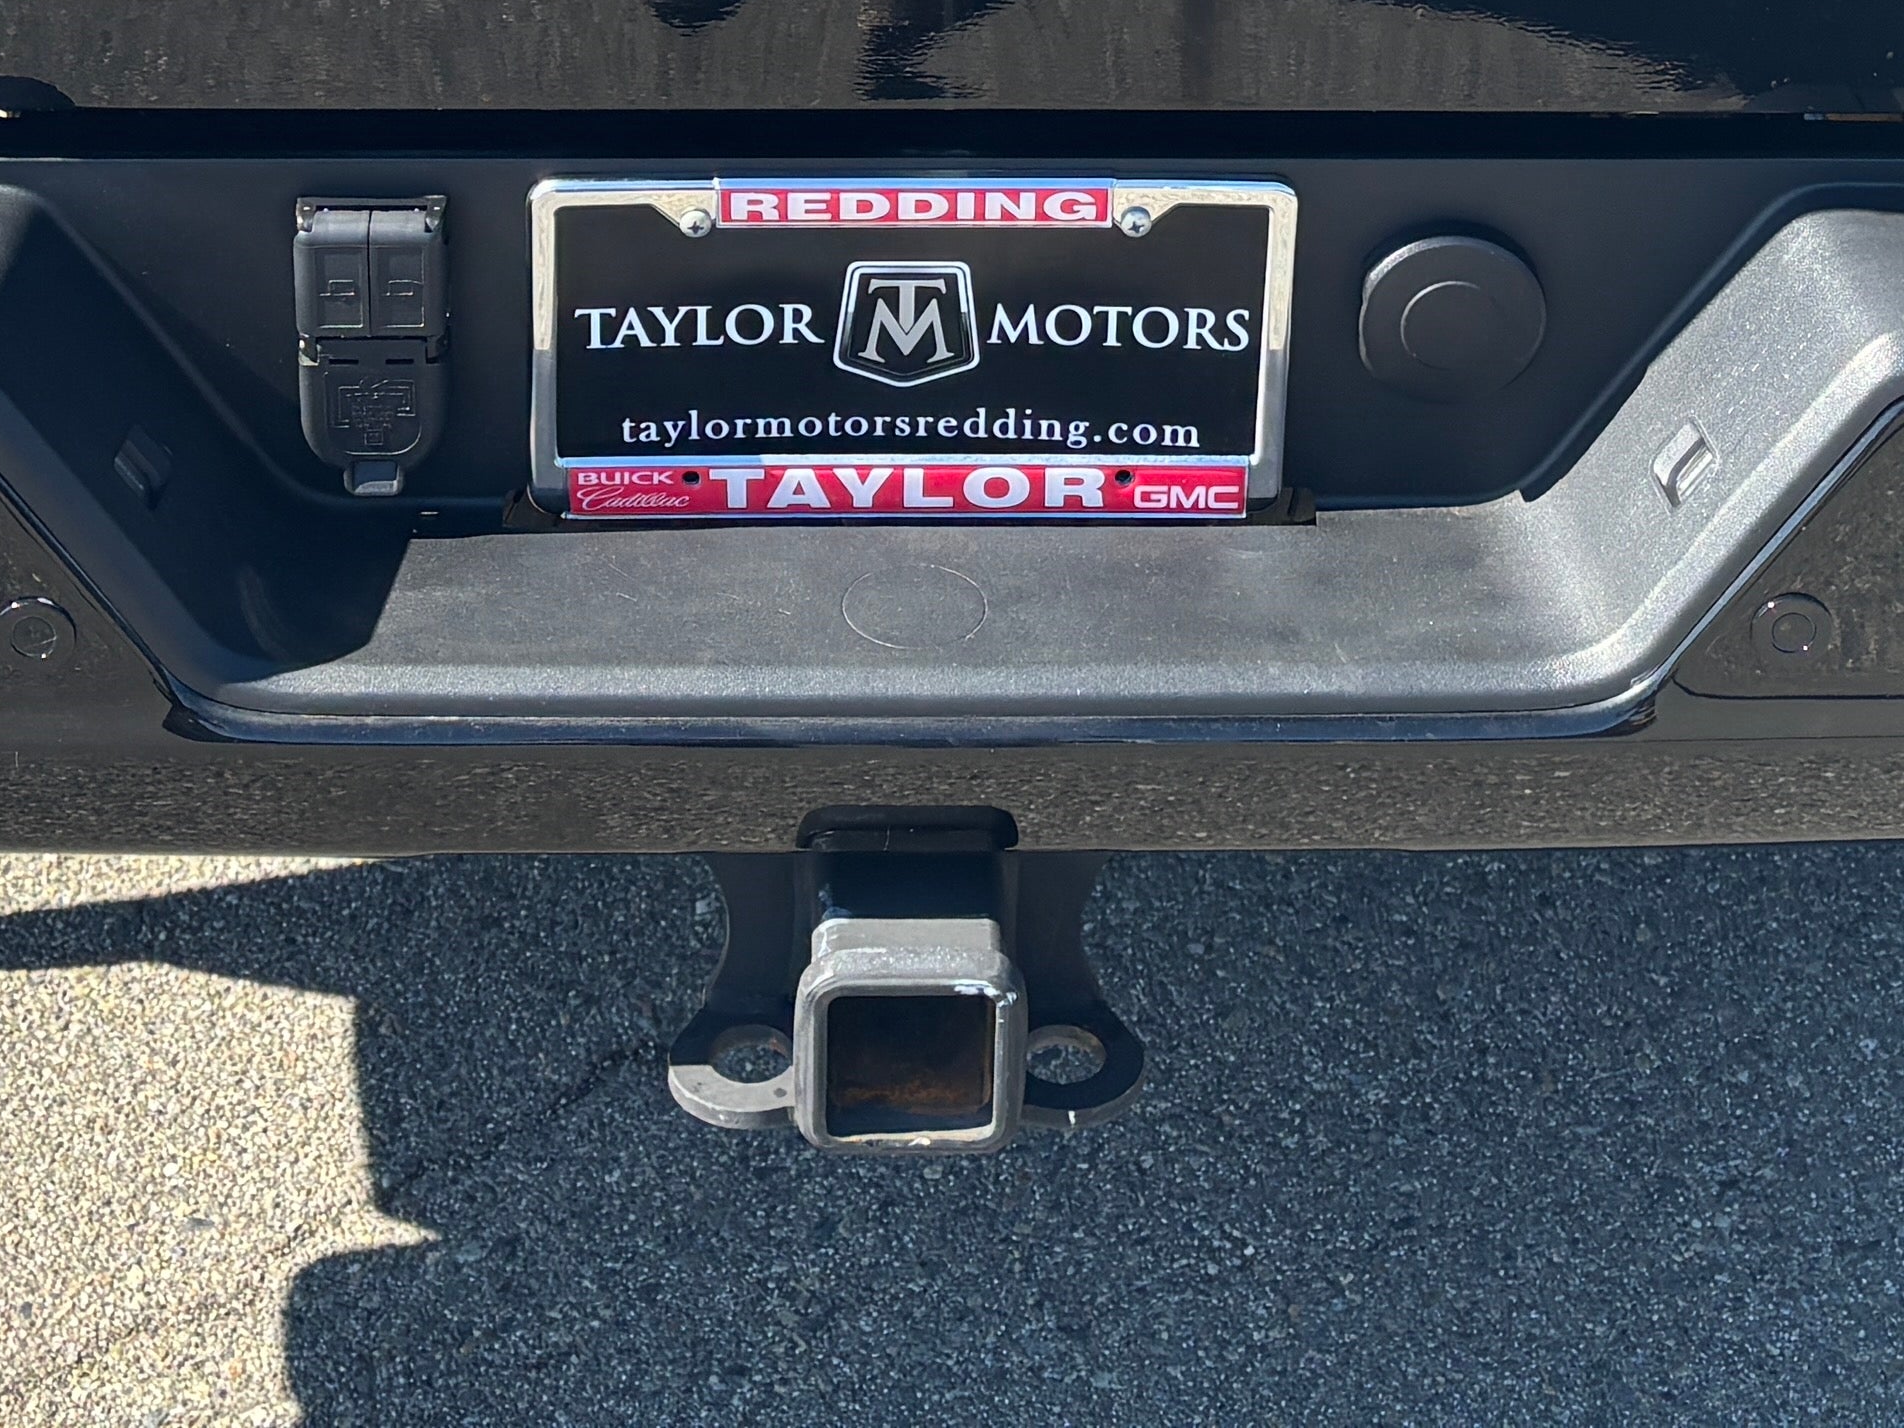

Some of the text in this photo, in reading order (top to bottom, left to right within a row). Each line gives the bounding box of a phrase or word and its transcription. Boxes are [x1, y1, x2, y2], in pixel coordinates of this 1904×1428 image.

[729, 190, 1097, 222] REDDING
[574, 304, 825, 349] TAYLOR
[986, 302, 1250, 352] MOTORS
[621, 407, 1200, 448] taylormotorsredding.com
[577, 471, 674, 486] BUICK
[709, 467, 1106, 509] TAYLOR
[576, 486, 690, 511] Cadillac
[1133, 485, 1240, 509] GMC
